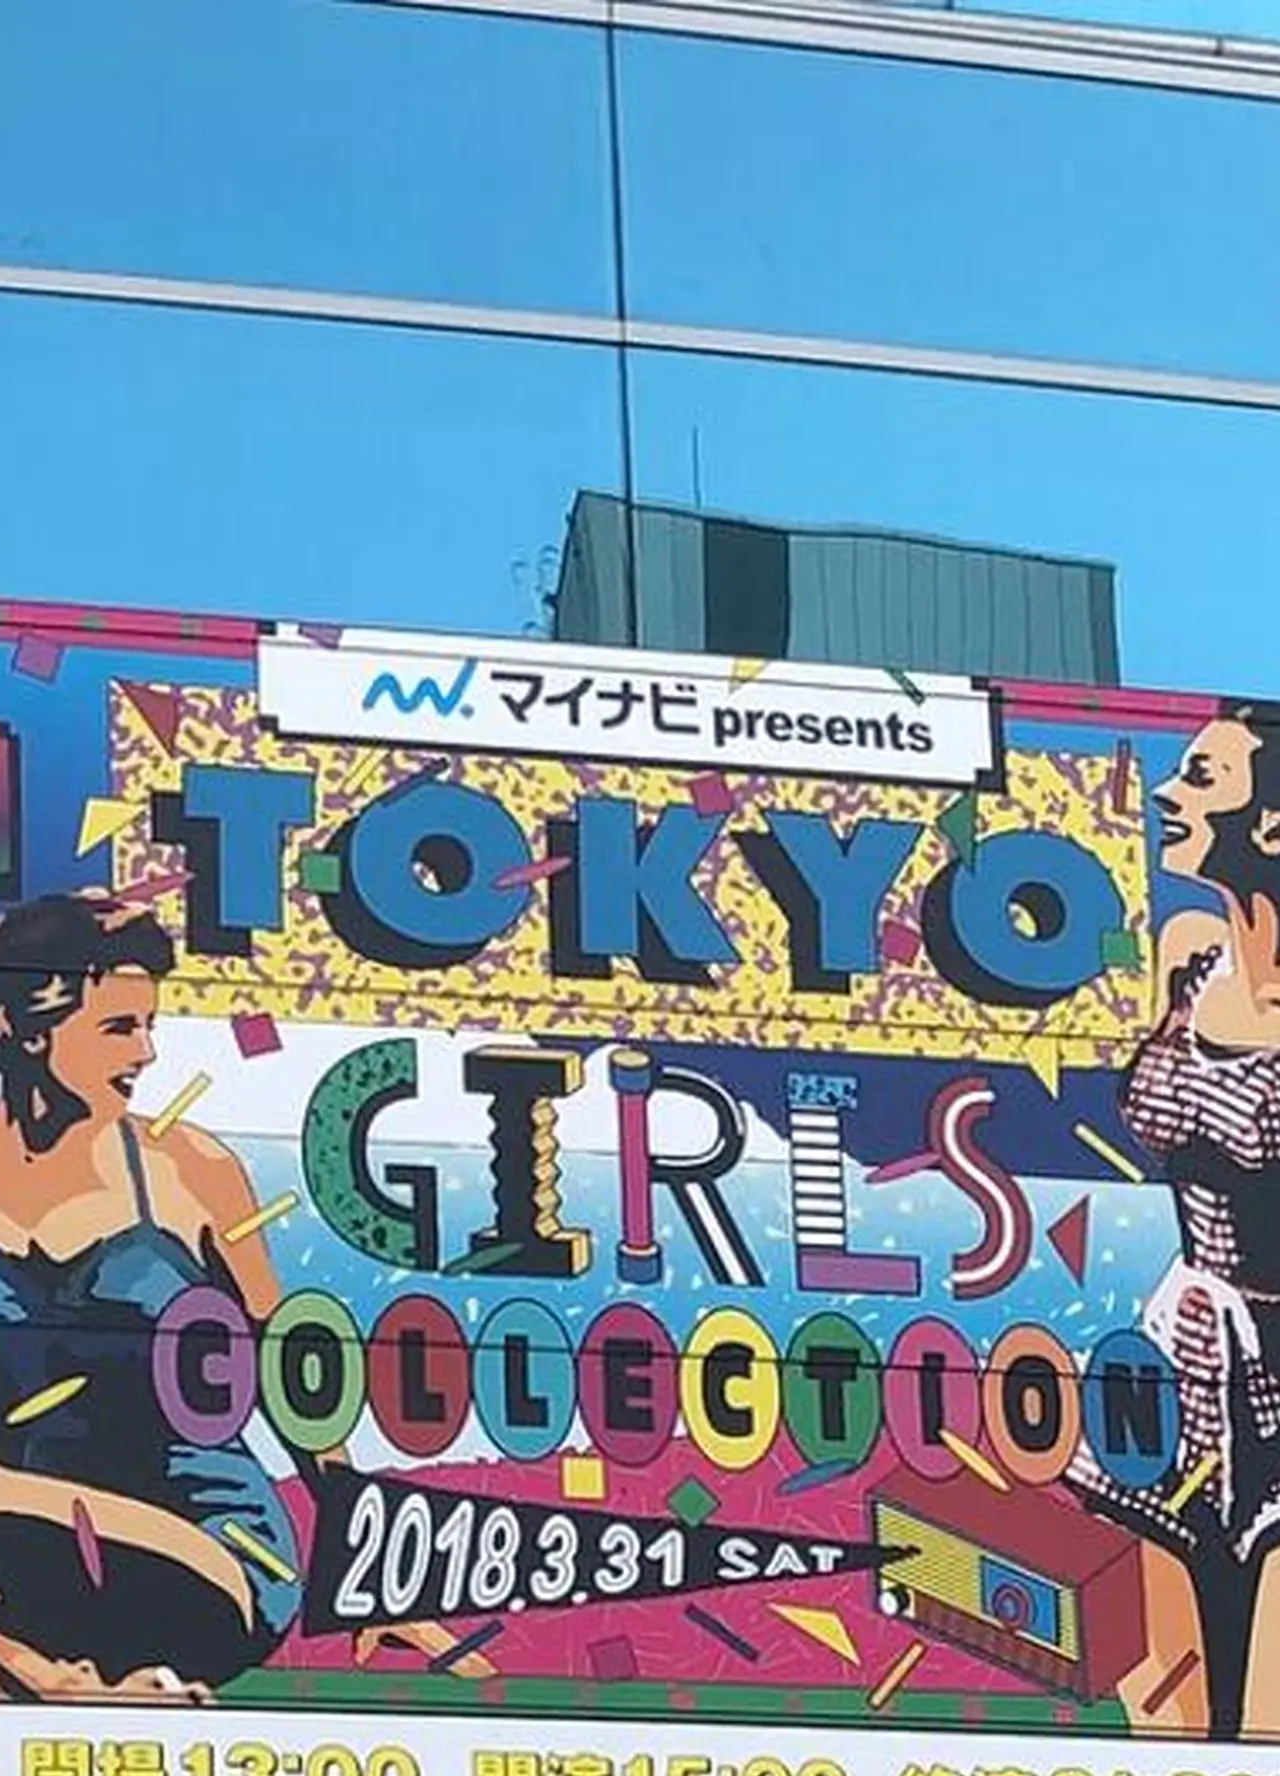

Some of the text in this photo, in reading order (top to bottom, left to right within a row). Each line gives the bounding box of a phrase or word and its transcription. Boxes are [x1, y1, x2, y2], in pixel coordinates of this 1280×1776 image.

[490, 670, 935, 755] マイナビ presents
[151, 762, 1126, 1008] TOKYO
[301, 1036, 1034, 1300] GIRLS
[170, 1308, 1169, 1459] COLLECTION
[330, 1482, 846, 1625] 2018.3.31 SAT
